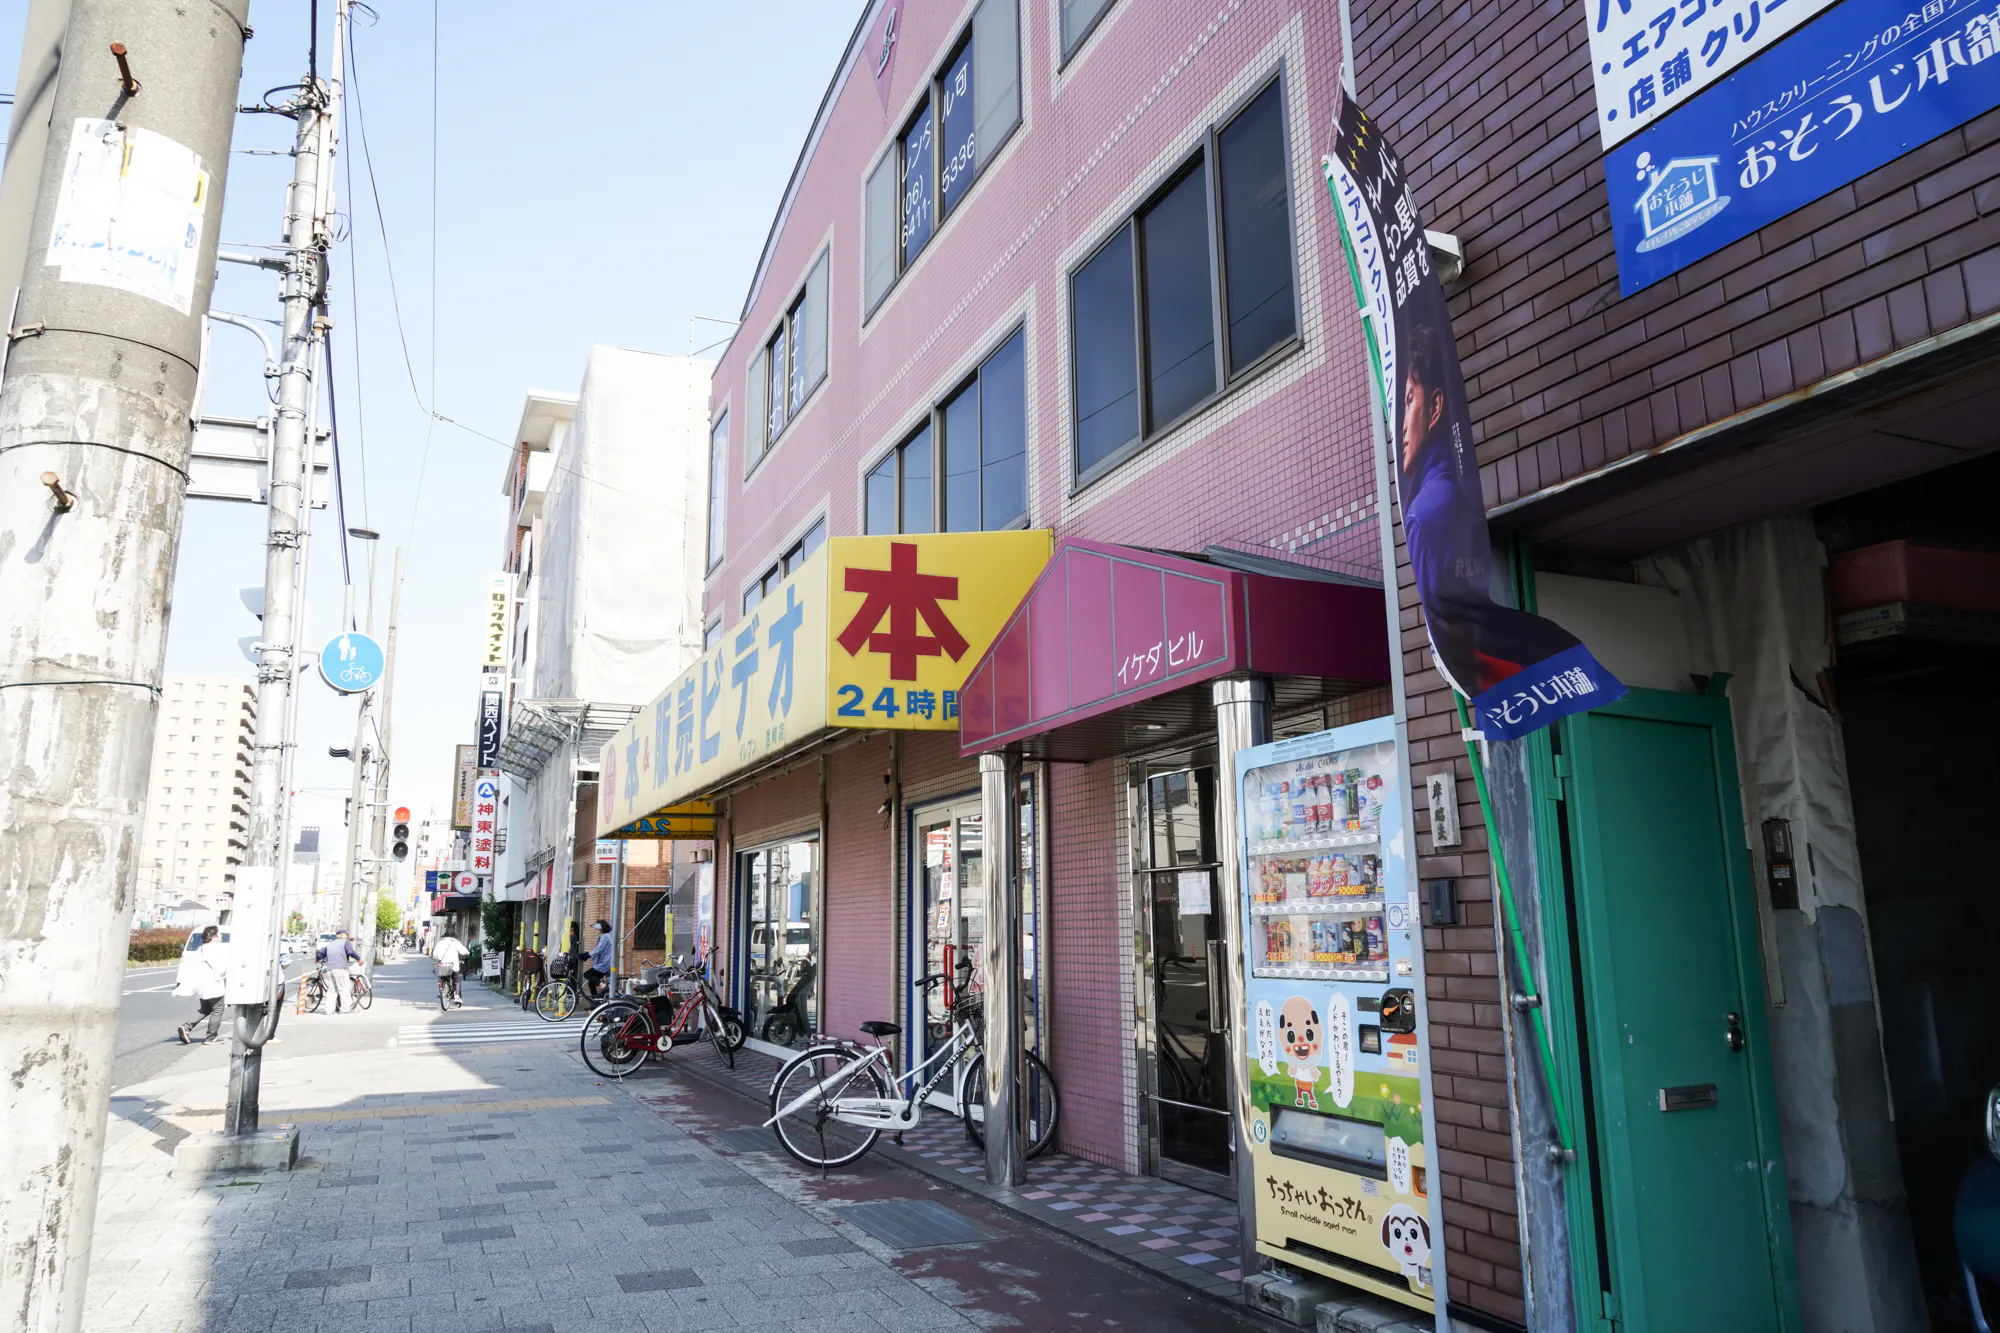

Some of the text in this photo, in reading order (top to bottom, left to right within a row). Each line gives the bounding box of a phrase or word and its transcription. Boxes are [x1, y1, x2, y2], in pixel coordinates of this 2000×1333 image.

[1628, 47, 1692, 119] 店舗
[901, 174, 924, 221] (06)
[1364, 138, 1398, 214] キレイに
[1649, 168, 1706, 211] おそうじ
[1664, 190, 1694, 218] 本舗
[1394, 237, 1430, 309] 品質を
[488, 592, 506, 663] ロックペイント
[837, 541, 971, 682] 本
[1117, 630, 1204, 684] イケダビル
[482, 692, 500, 767] 関西ペイント
[474, 802, 495, 870] 神東塗料
[461, 876, 473, 888] P
[1280, 1205, 1358, 1236] Small middle aged man
